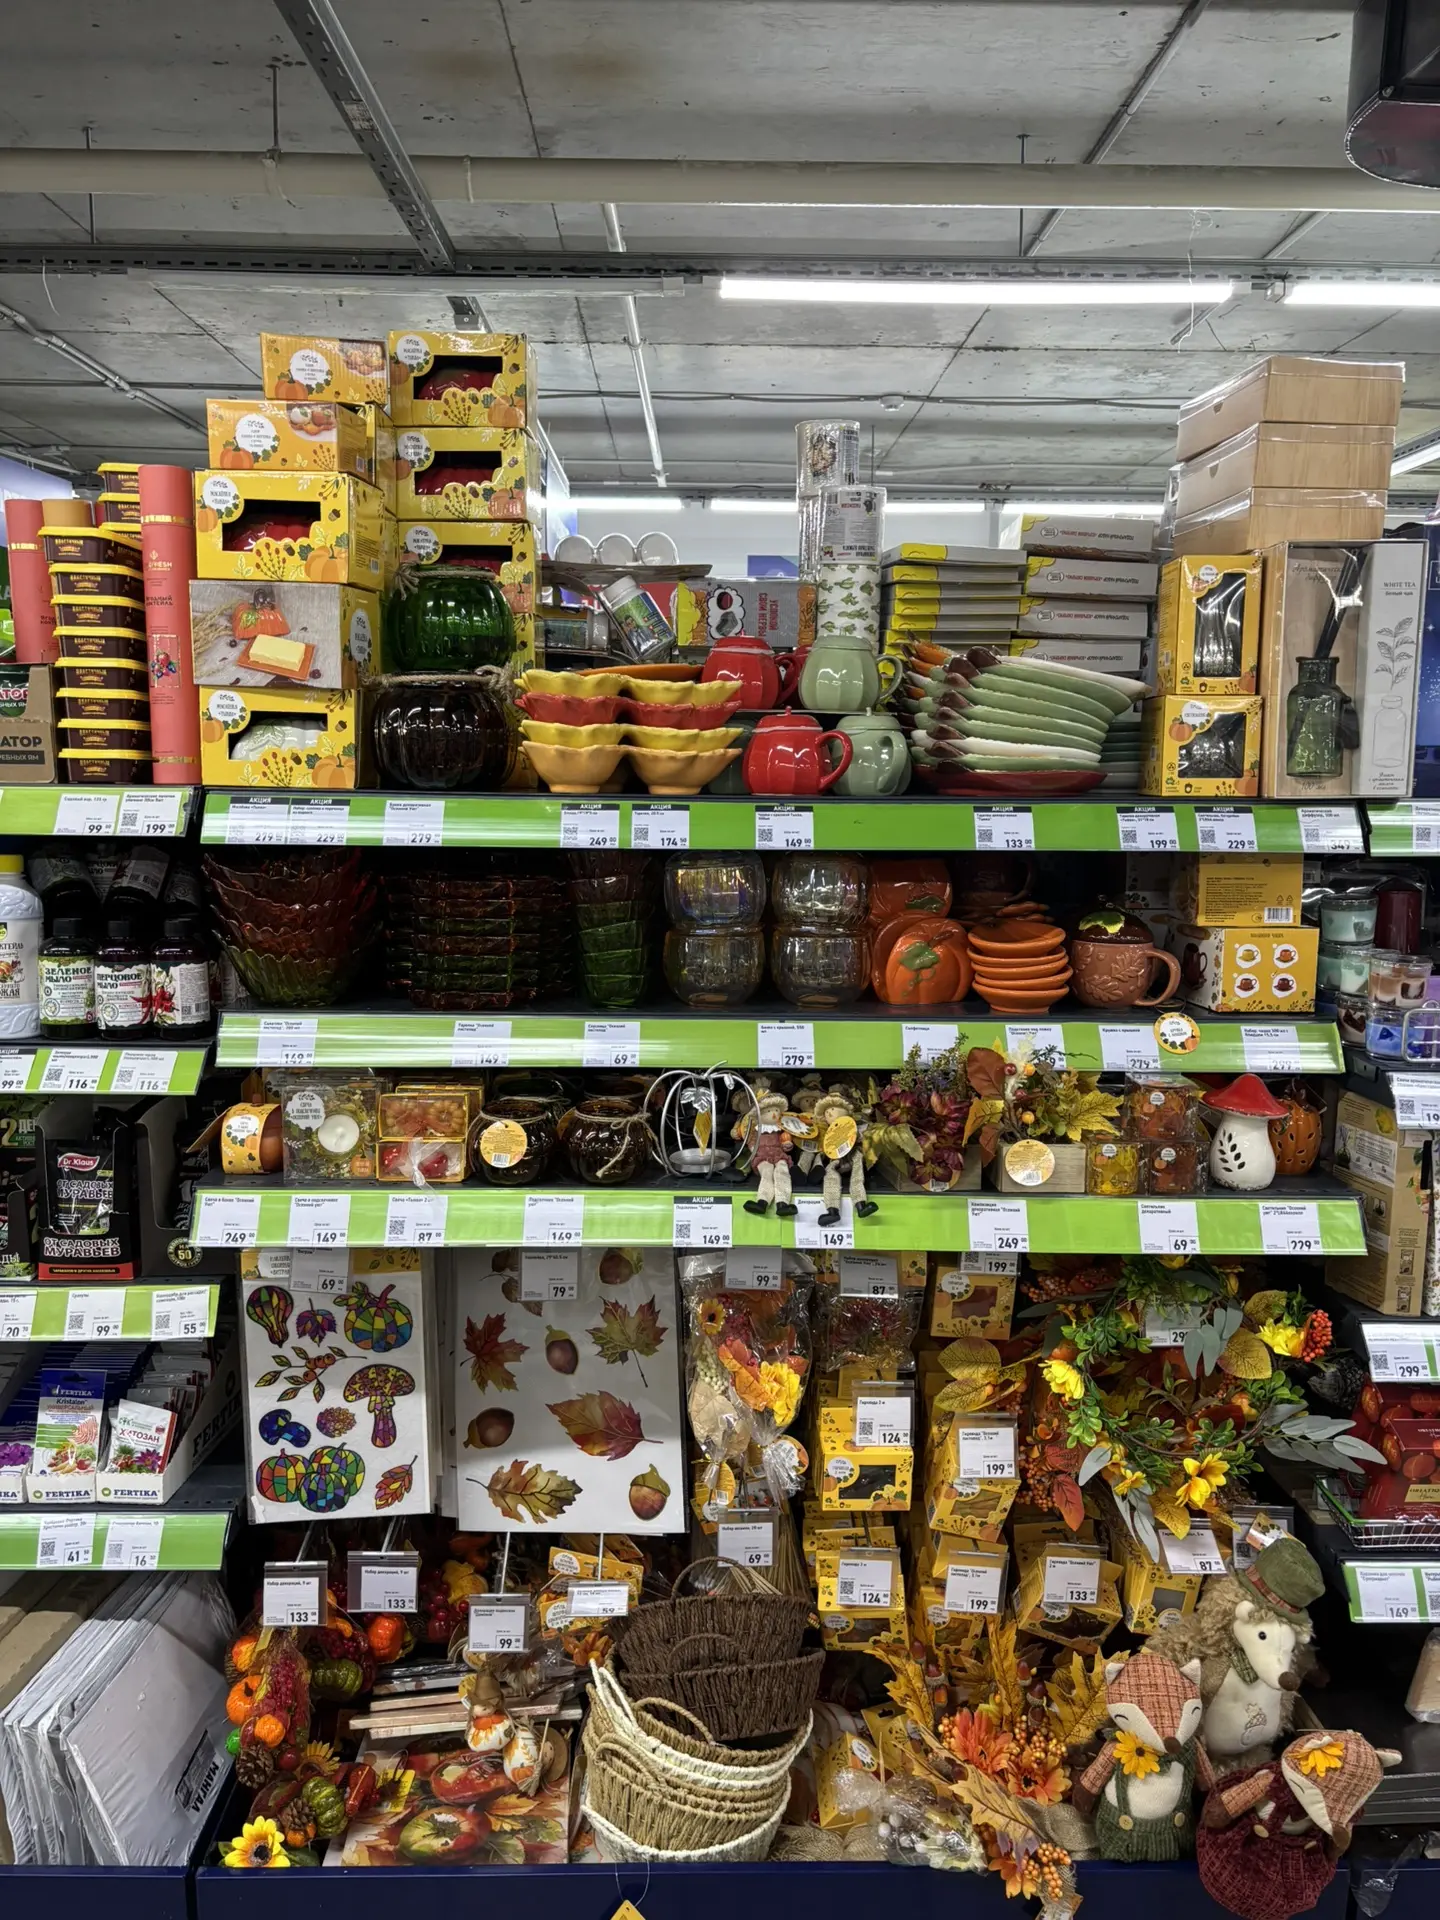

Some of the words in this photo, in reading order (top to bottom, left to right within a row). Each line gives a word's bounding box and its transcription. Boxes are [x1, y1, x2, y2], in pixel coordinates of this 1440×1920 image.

[88, 824, 102, 834] 99
[145, 824, 166, 834] 199
[255, 832, 274, 842] 279
[316, 833, 335, 843] 229
[410, 833, 432, 844] 279
[589, 837, 607, 846] 249
[660, 838, 678, 846] 174
[785, 839, 802, 848] 149
[1005, 839, 1023, 848] 133
[1150, 840, 1167, 849] 199
[1227, 840, 1245, 849] 229
[45, 975, 72, 983] МЫЛО
[97, 973, 143, 981] ПЕРЦОВОЕ
[480, 1054, 499, 1065] 149
[614, 1054, 628, 1064] 69
[785, 1055, 805, 1066] 279
[1, 1080, 14, 1089] 99
[68, 1080, 87, 1089] 116
[139, 1081, 159, 1090] 116
[0, 1119, 18, 1147] 2
[63, 1157, 95, 1167] Dr.Klaus
[57, 1179, 70, 1188] ОТ
[71, 1180, 113, 1190] САДОВЫХ
[225, 1232, 246, 1243] 249
[316, 1232, 337, 1243] 149
[418, 1232, 432, 1241] 87
[552, 1232, 572, 1243] 149
[703, 1235, 720, 1245] 149
[824, 1234, 844, 1246] 149
[43, 1237, 59, 1247] ОТ
[59, 1237, 120, 1248] САДОВЫХ
[998, 1237, 1019, 1249] 249
[1173, 1239, 1188, 1250] 69
[1291, 1240, 1311, 1251] 229
[43, 1246, 121, 1258] МУРАВЬЕВ
[178, 1250, 192, 1260] 50
[988, 1262, 1007, 1272] 199
[321, 1279, 336, 1290] 69
[756, 1275, 770, 1286] 99
[553, 1286, 566, 1297] 79
[872, 1286, 885, 1295] 87
[6, 1327, 19, 1337] 20
[96, 1325, 110, 1337] 99
[184, 1323, 197, 1334] 55
[1399, 1365, 1420, 1377] 299
[60, 1389, 93, 1397] FERTIKA
[882, 1433, 900, 1443] 124
[986, 1464, 1005, 1475] 199
[45, 1489, 91, 1498] FERTIKA
[114, 1489, 158, 1497] FERTIKA
[67, 1551, 80, 1562] 41
[134, 1555, 147, 1566] 16
[748, 1554, 761, 1564] 69
[1199, 1561, 1212, 1571] 87
[862, 1593, 881, 1604] 124
[1069, 1591, 1088, 1601] 133
[388, 1599, 406, 1610] 133
[970, 1599, 988, 1610] 199
[290, 1612, 309, 1623] 133
[1389, 1607, 1409, 1618] 149
[499, 1639, 512, 1649] 99
[191, 1761, 220, 1813] МАНГАЛ
